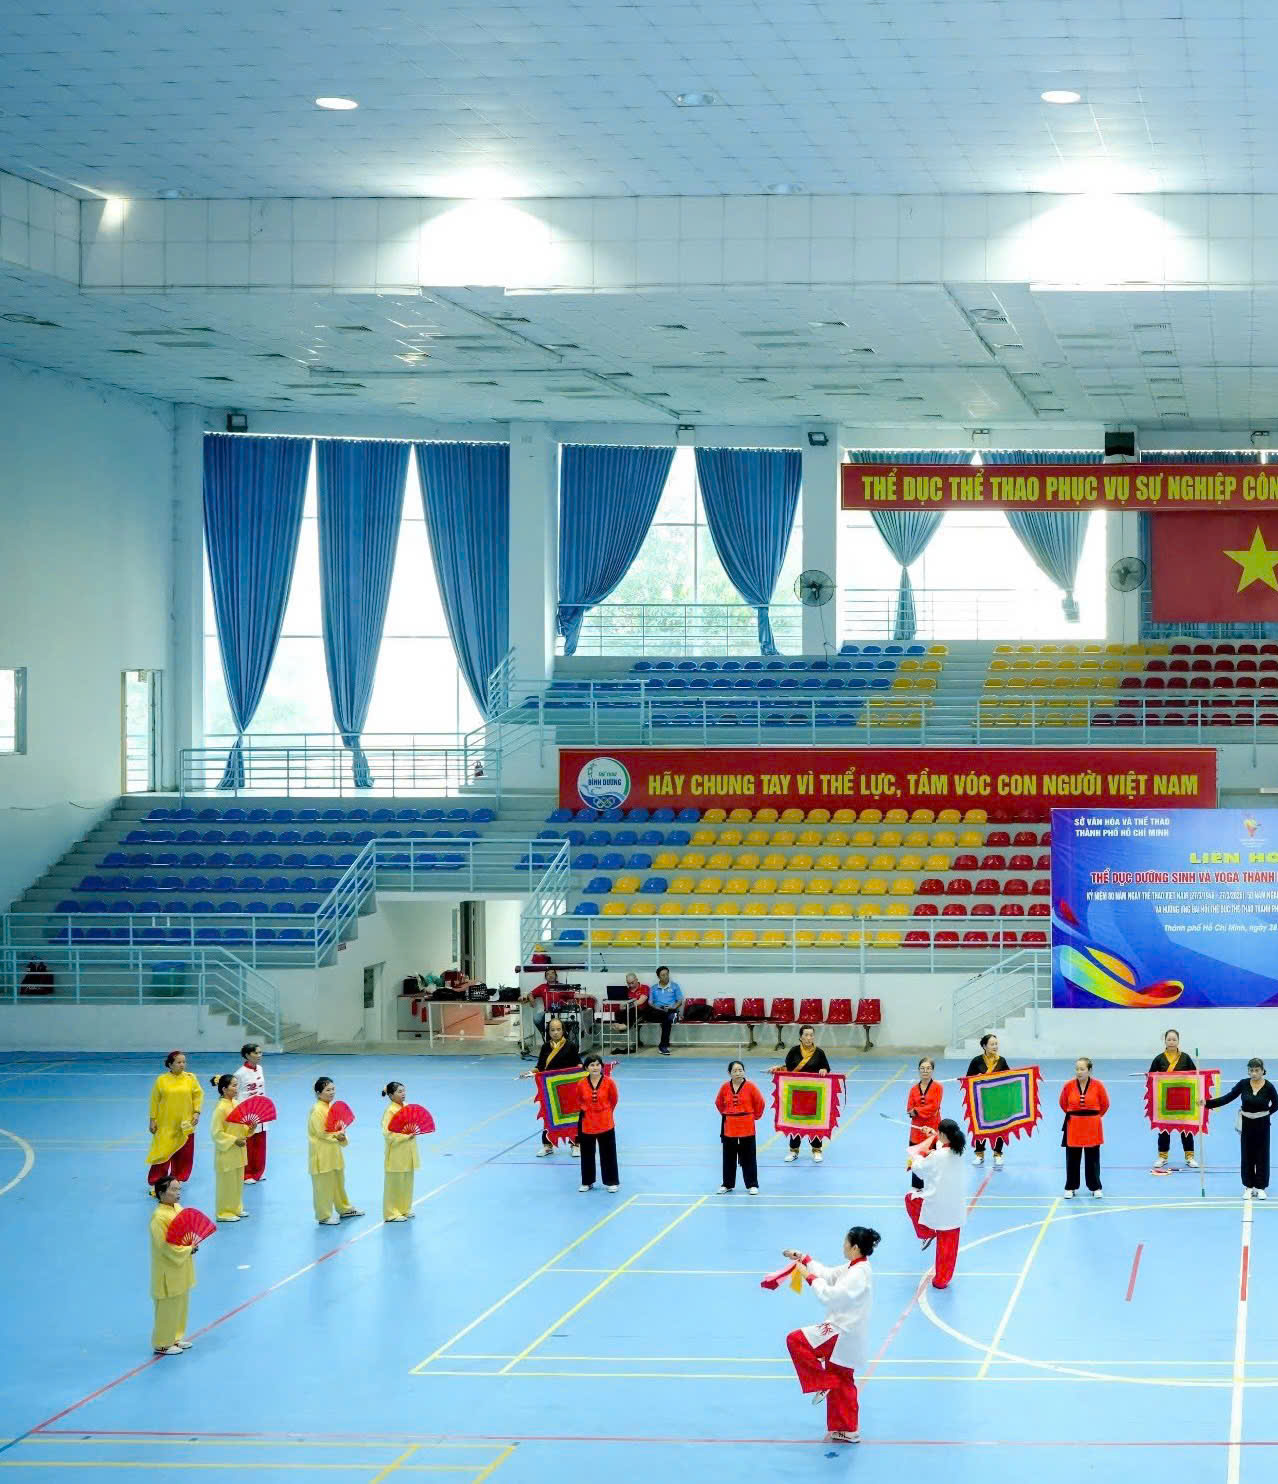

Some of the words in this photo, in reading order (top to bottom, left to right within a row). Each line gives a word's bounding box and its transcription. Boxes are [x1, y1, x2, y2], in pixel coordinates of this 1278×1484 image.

[862, 468, 897, 500] THỂ
[903, 476, 943, 505] DỤC
[949, 468, 984, 501] THỂ
[990, 477, 1039, 501] THAO
[1046, 476, 1098, 505] PHỤC
[1104, 476, 1129, 504] VỤ
[1136, 472, 1163, 504] SỰ
[1168, 472, 1236, 504] NGHIỆP
[648, 771, 685, 795] HÃY
[691, 775, 755, 795] CHUNG
[761, 775, 791, 795] TAY
[797, 771, 814, 795] VÌ
[820, 767, 855, 795] THỂ
[861, 773, 901, 799] LỰC,
[907, 768, 948, 795] TẦM
[954, 771, 990, 795] VÓC
[998, 775, 1036, 795] CON
[1043, 770, 1101, 795] NGƯỜI
[1107, 771, 1147, 799] VIỆT
[1154, 775, 1198, 795] NAM
[1148, 829, 1168, 837] MINH
[1091, 868, 1110, 883] THỂ
[1112, 871, 1132, 886] DỤC
[1135, 870, 1169, 883] DƯỠNG
[1171, 871, 1196, 883] SINH
[1198, 869, 1211, 883] VÀ
[1214, 871, 1240, 883] YOGA
[1242, 869, 1275, 883] THÀNH
